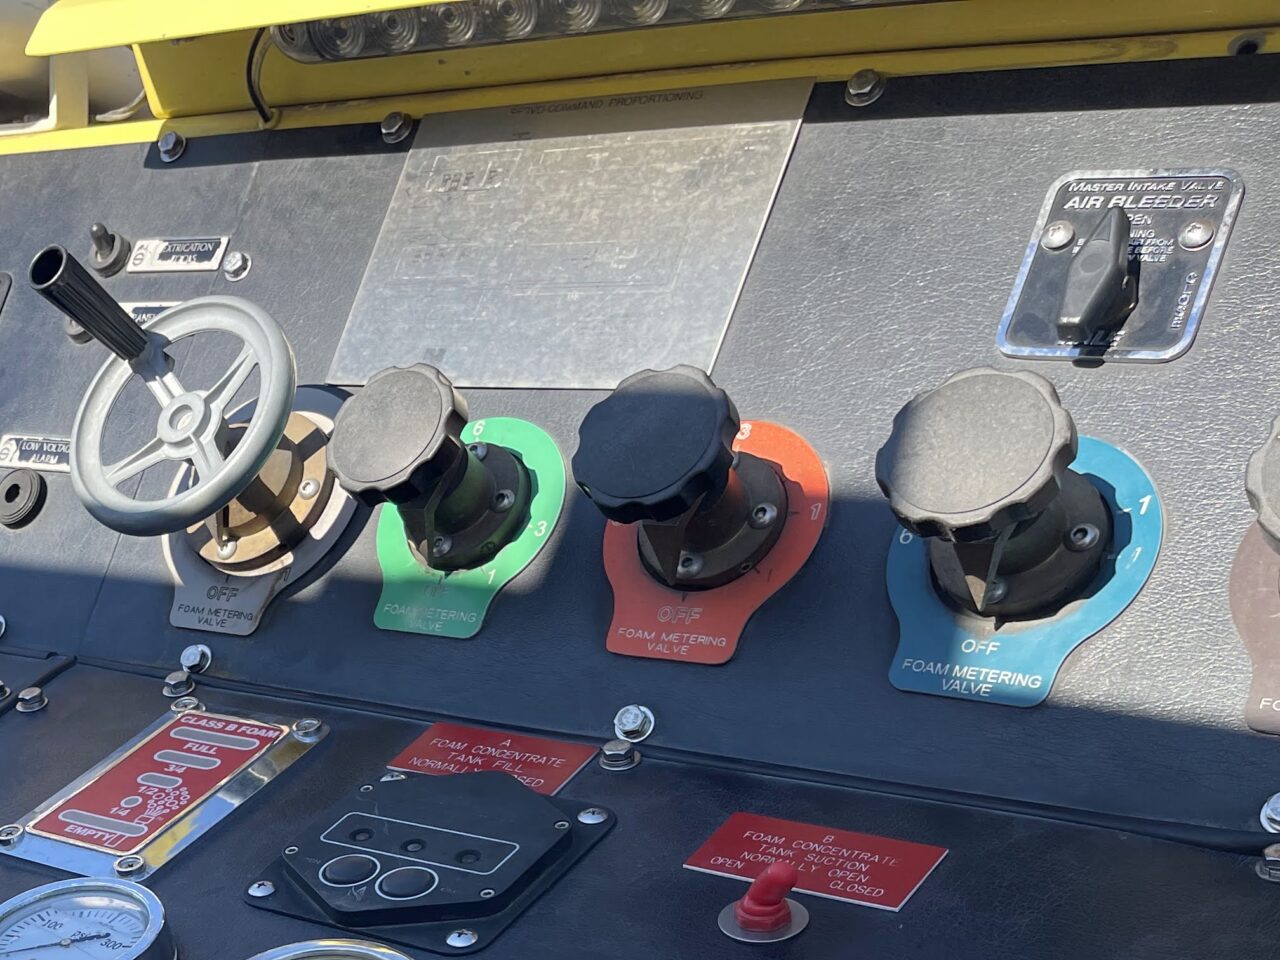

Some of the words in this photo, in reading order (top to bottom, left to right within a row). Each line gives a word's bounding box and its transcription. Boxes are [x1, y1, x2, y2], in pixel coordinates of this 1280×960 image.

[608, 89, 704, 108] PROPORTIONING
[1063, 196, 1104, 209] AIR
[1107, 195, 1219, 209] BLEEDER
[1127, 214, 1153, 225] PEN
[472, 420, 485, 436] 6
[736, 423, 752, 440] 3
[21, 441, 41, 451] LOW
[811, 503, 821, 520] 1
[534, 520, 547, 537] 3
[899, 529, 914, 545] 6
[487, 569, 496, 584] 1
[206, 586, 239, 601] OFF
[178, 603, 207, 615] FOAM
[209, 607, 253, 622] METERING
[657, 605, 703, 625] OFF
[197, 616, 227, 628] VALVE
[618, 628, 656, 640] FOAM
[661, 633, 726, 647] METERING
[647, 642, 689, 655] VALVE
[961, 639, 1000, 656] OFF
[902, 659, 950, 676] FOAM
[952, 665, 1043, 689] METERING
[941, 679, 993, 697] VALVE
[180, 716, 226, 729] CLASS
[237, 726, 280, 738] FOAM
[183, 742, 219, 754] FULL
[500, 739, 512, 747] A
[429, 738, 468, 750] FOAM
[472, 745, 566, 767] CONCENTRATE
[164, 764, 187, 774] 3/4
[448, 752, 485, 766] TANK
[492, 760, 524, 773] FILL
[138, 785, 159, 795] 1/2
[110, 806, 131, 816] 1/4
[64, 825, 115, 841] EMPTY
[822, 835, 834, 843] B
[743, 830, 785, 845] FOAM
[791, 840, 903, 866] CONCENTRATE
[759, 844, 795, 857] TANK
[805, 853, 870, 872] SUCTION
[710, 856, 746, 870] OPEN
[829, 880, 885, 897] CLOSED
[828, 869, 870, 883] OPEN
[42, 920, 64, 930] 100
[100, 939, 121, 950] 300
